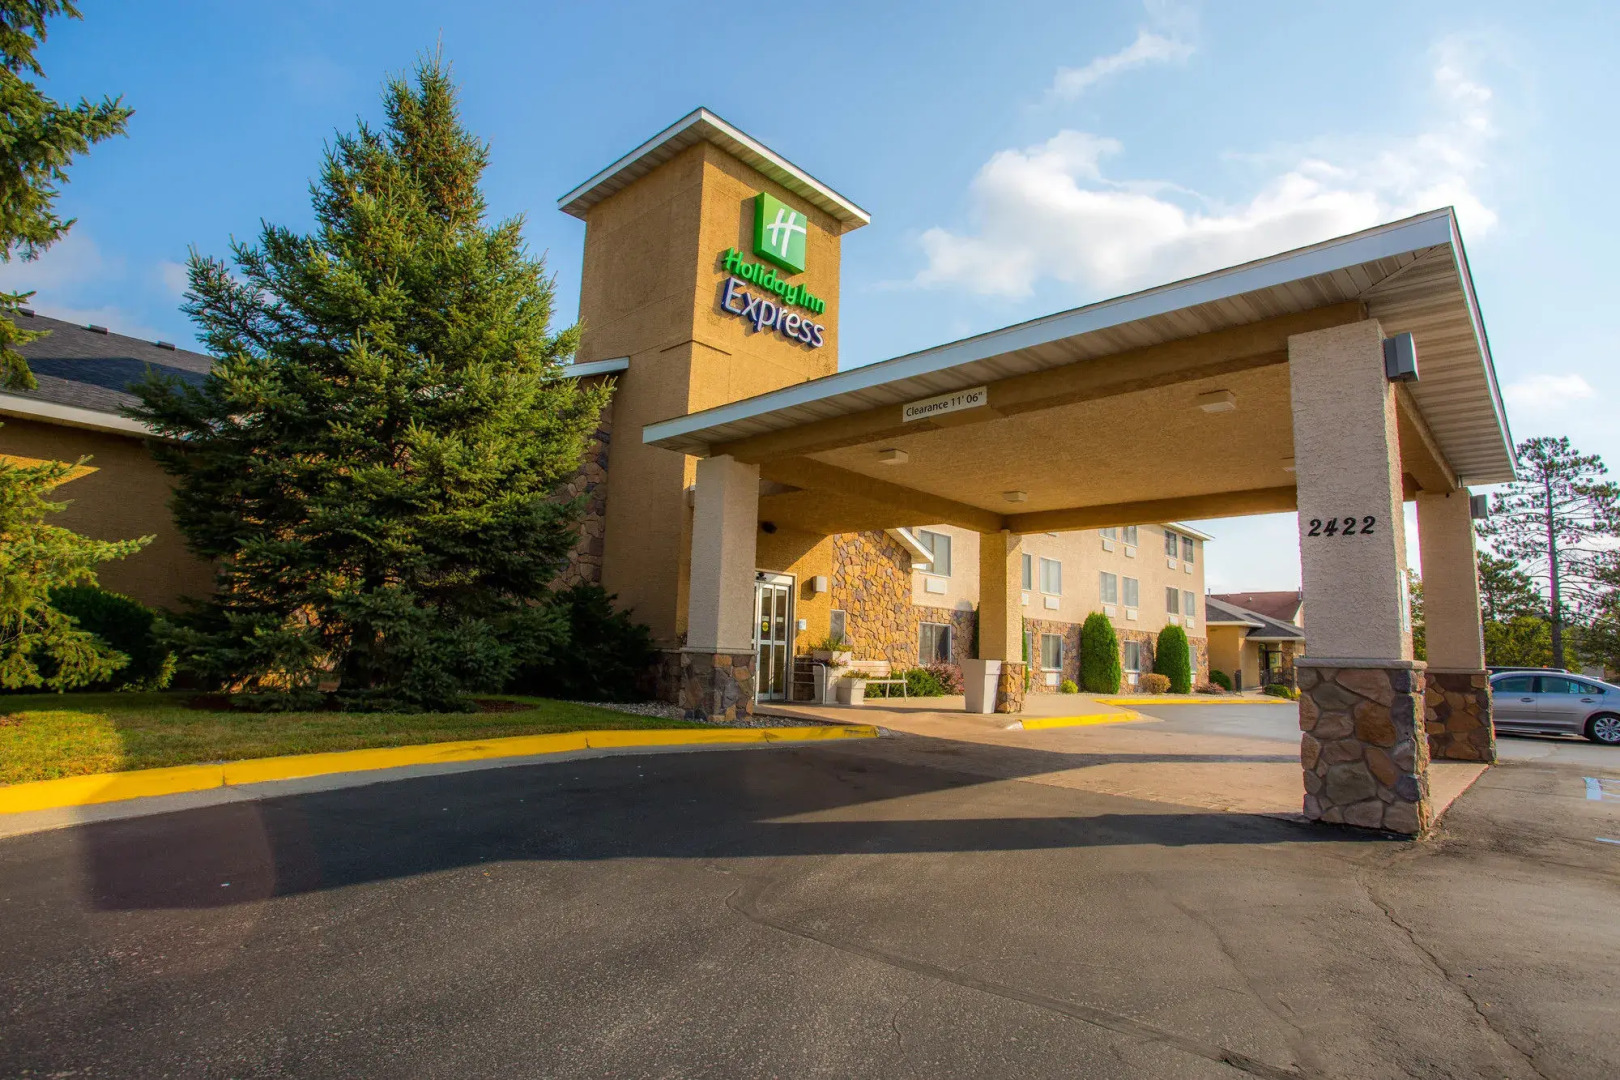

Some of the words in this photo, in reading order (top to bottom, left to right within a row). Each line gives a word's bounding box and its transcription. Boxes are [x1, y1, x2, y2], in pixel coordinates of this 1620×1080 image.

[721, 247, 798, 305] Holiday
[799, 284, 826, 315] Inn
[722, 277, 825, 348] Express
[906, 401, 949, 417] Clearance
[1307, 515, 1376, 537] 2422
